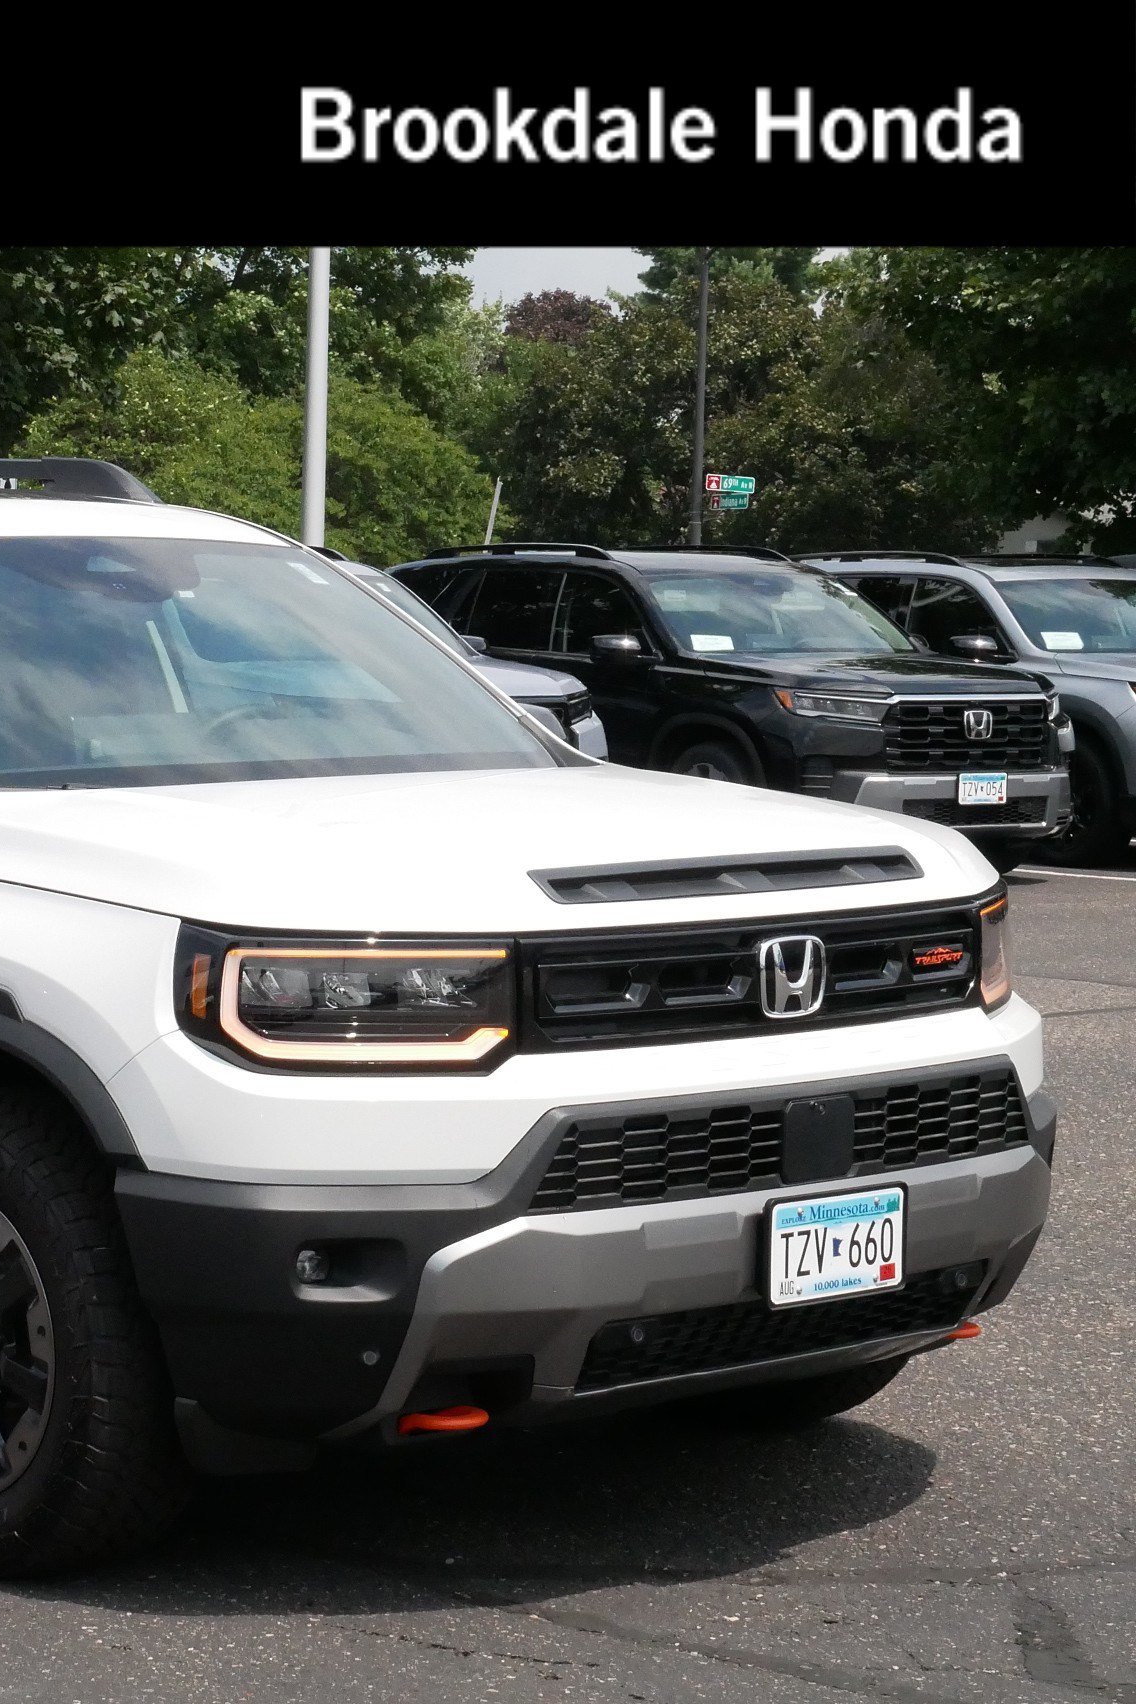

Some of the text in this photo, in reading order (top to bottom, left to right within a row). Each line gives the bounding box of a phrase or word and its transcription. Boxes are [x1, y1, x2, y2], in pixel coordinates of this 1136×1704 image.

[962, 781, 1003, 797] TZV 054
[780, 1217, 894, 1279] TZV 660
[779, 1280, 795, 1296] AUG
[841, 1276, 862, 1289] lakes
